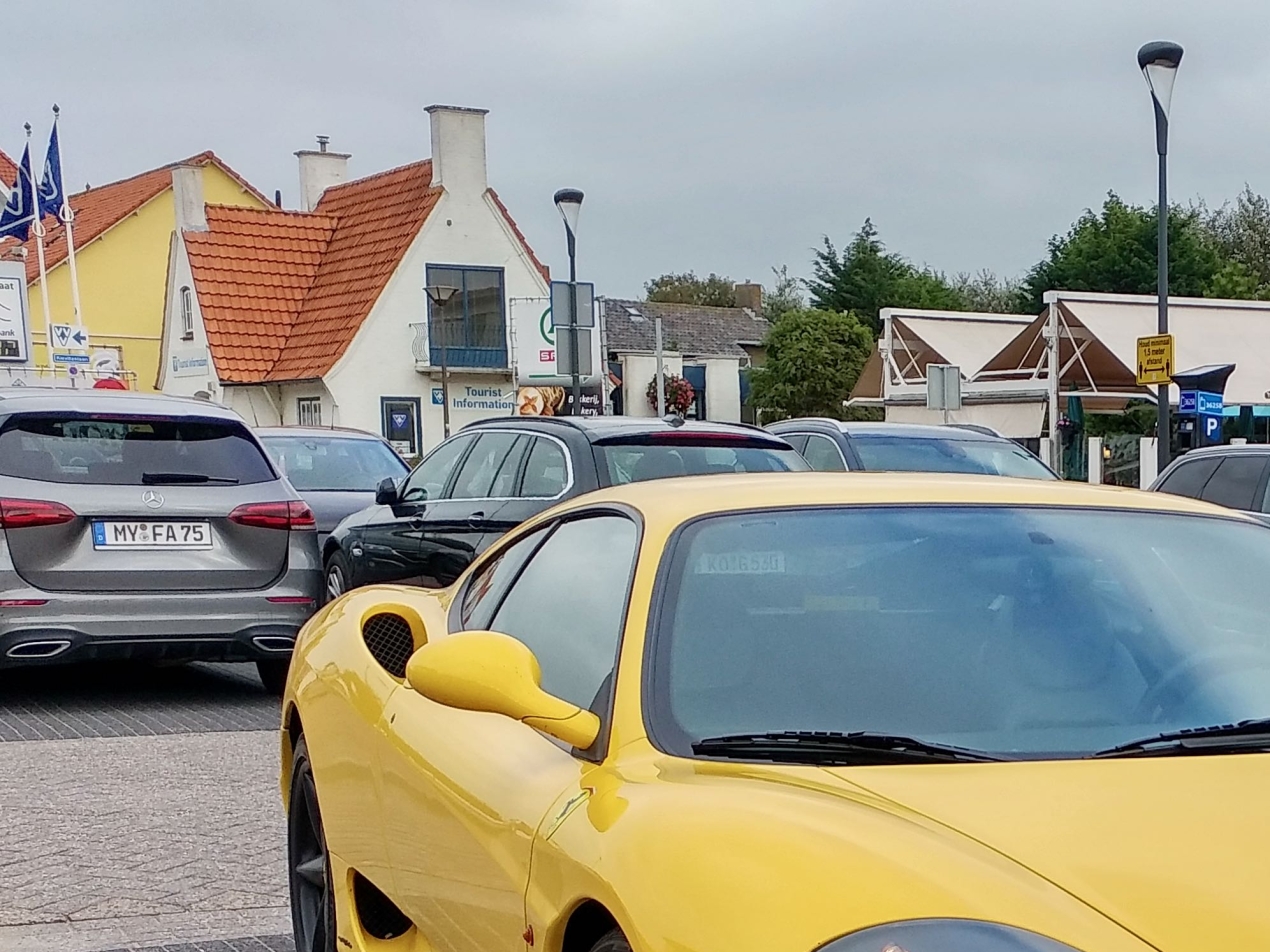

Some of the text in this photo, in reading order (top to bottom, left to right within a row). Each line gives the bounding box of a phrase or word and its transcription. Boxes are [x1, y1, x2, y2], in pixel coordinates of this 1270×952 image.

[465, 386, 502, 397] Tourist
[453, 398, 514, 409] Information
[1207, 418, 1218, 436] P
[113, 524, 139, 542] MY
